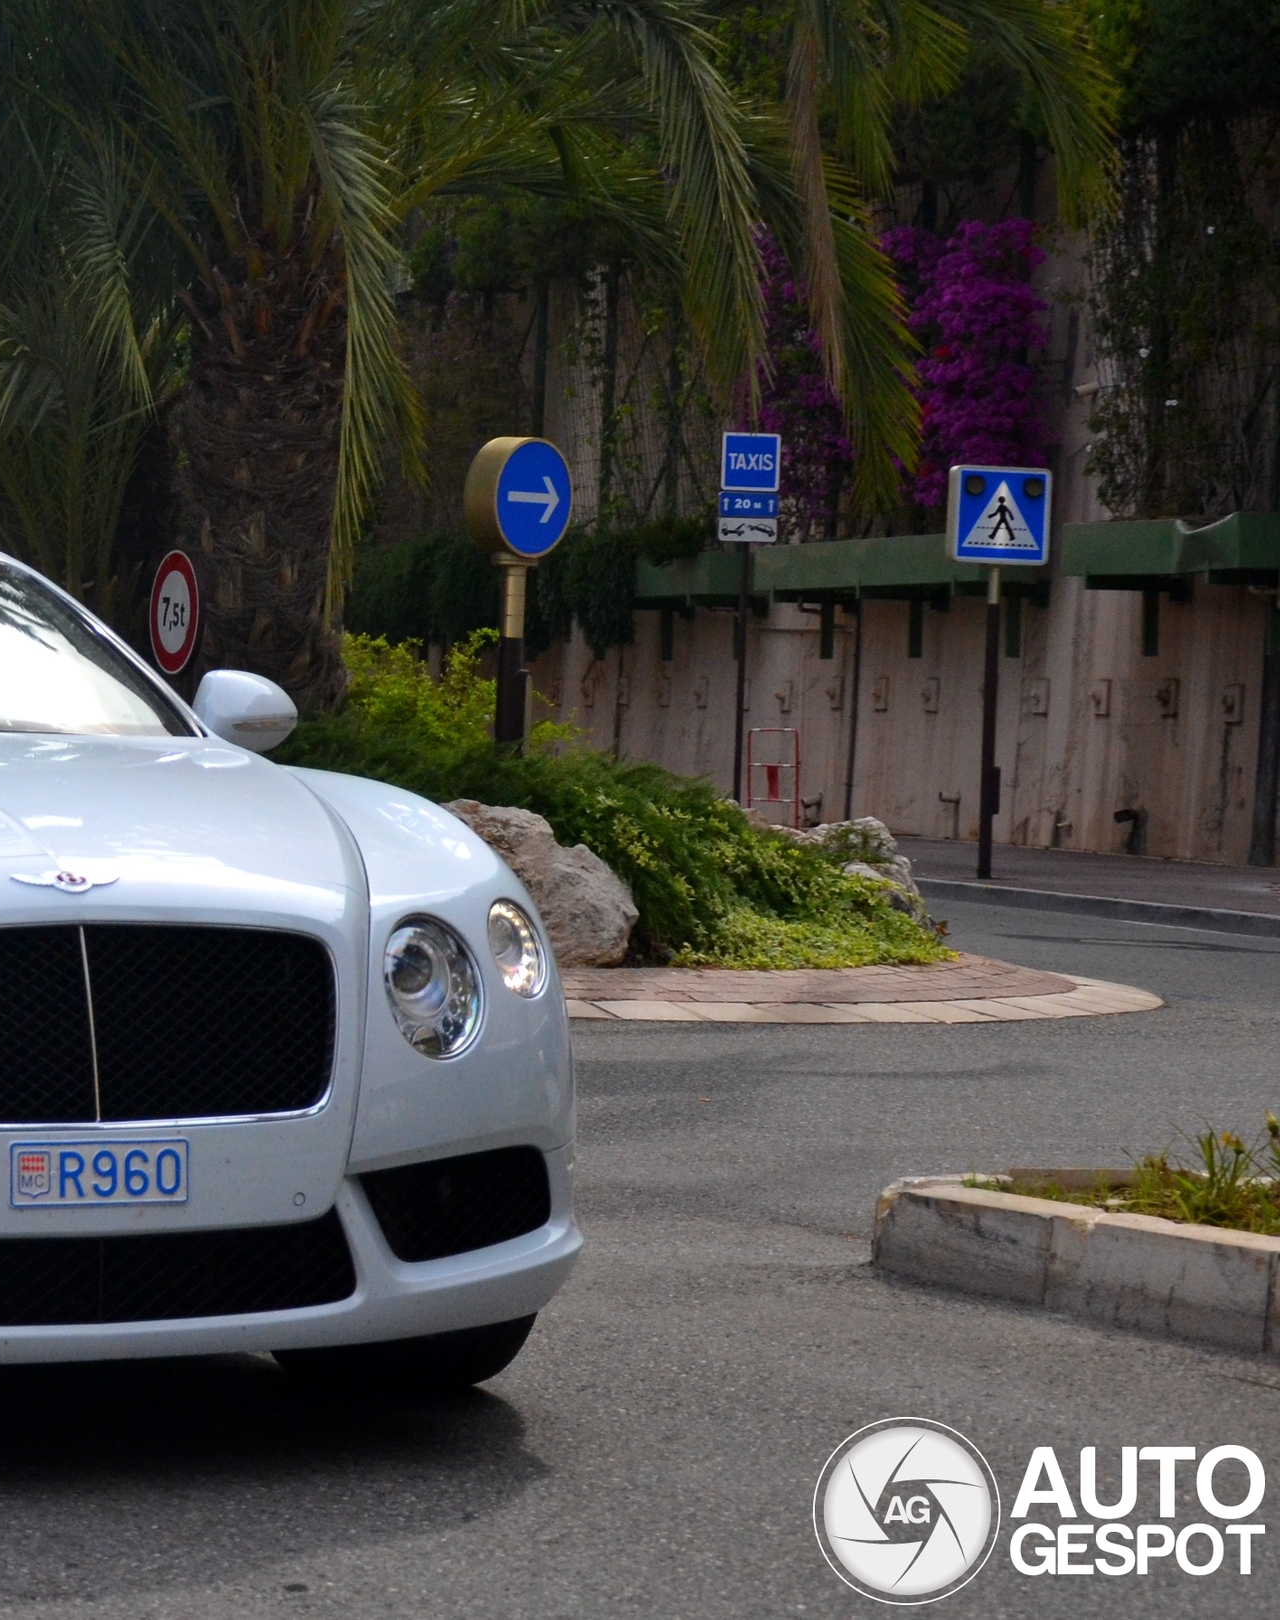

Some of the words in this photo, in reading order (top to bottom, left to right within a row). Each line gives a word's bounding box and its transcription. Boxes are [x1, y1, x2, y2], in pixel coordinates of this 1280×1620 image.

[728, 453, 774, 471] TAXIS
[734, 498, 751, 508] 20
[162, 597, 185, 631] 7,5t
[21, 1175, 45, 1188] MC
[59, 1149, 181, 1197] R960
